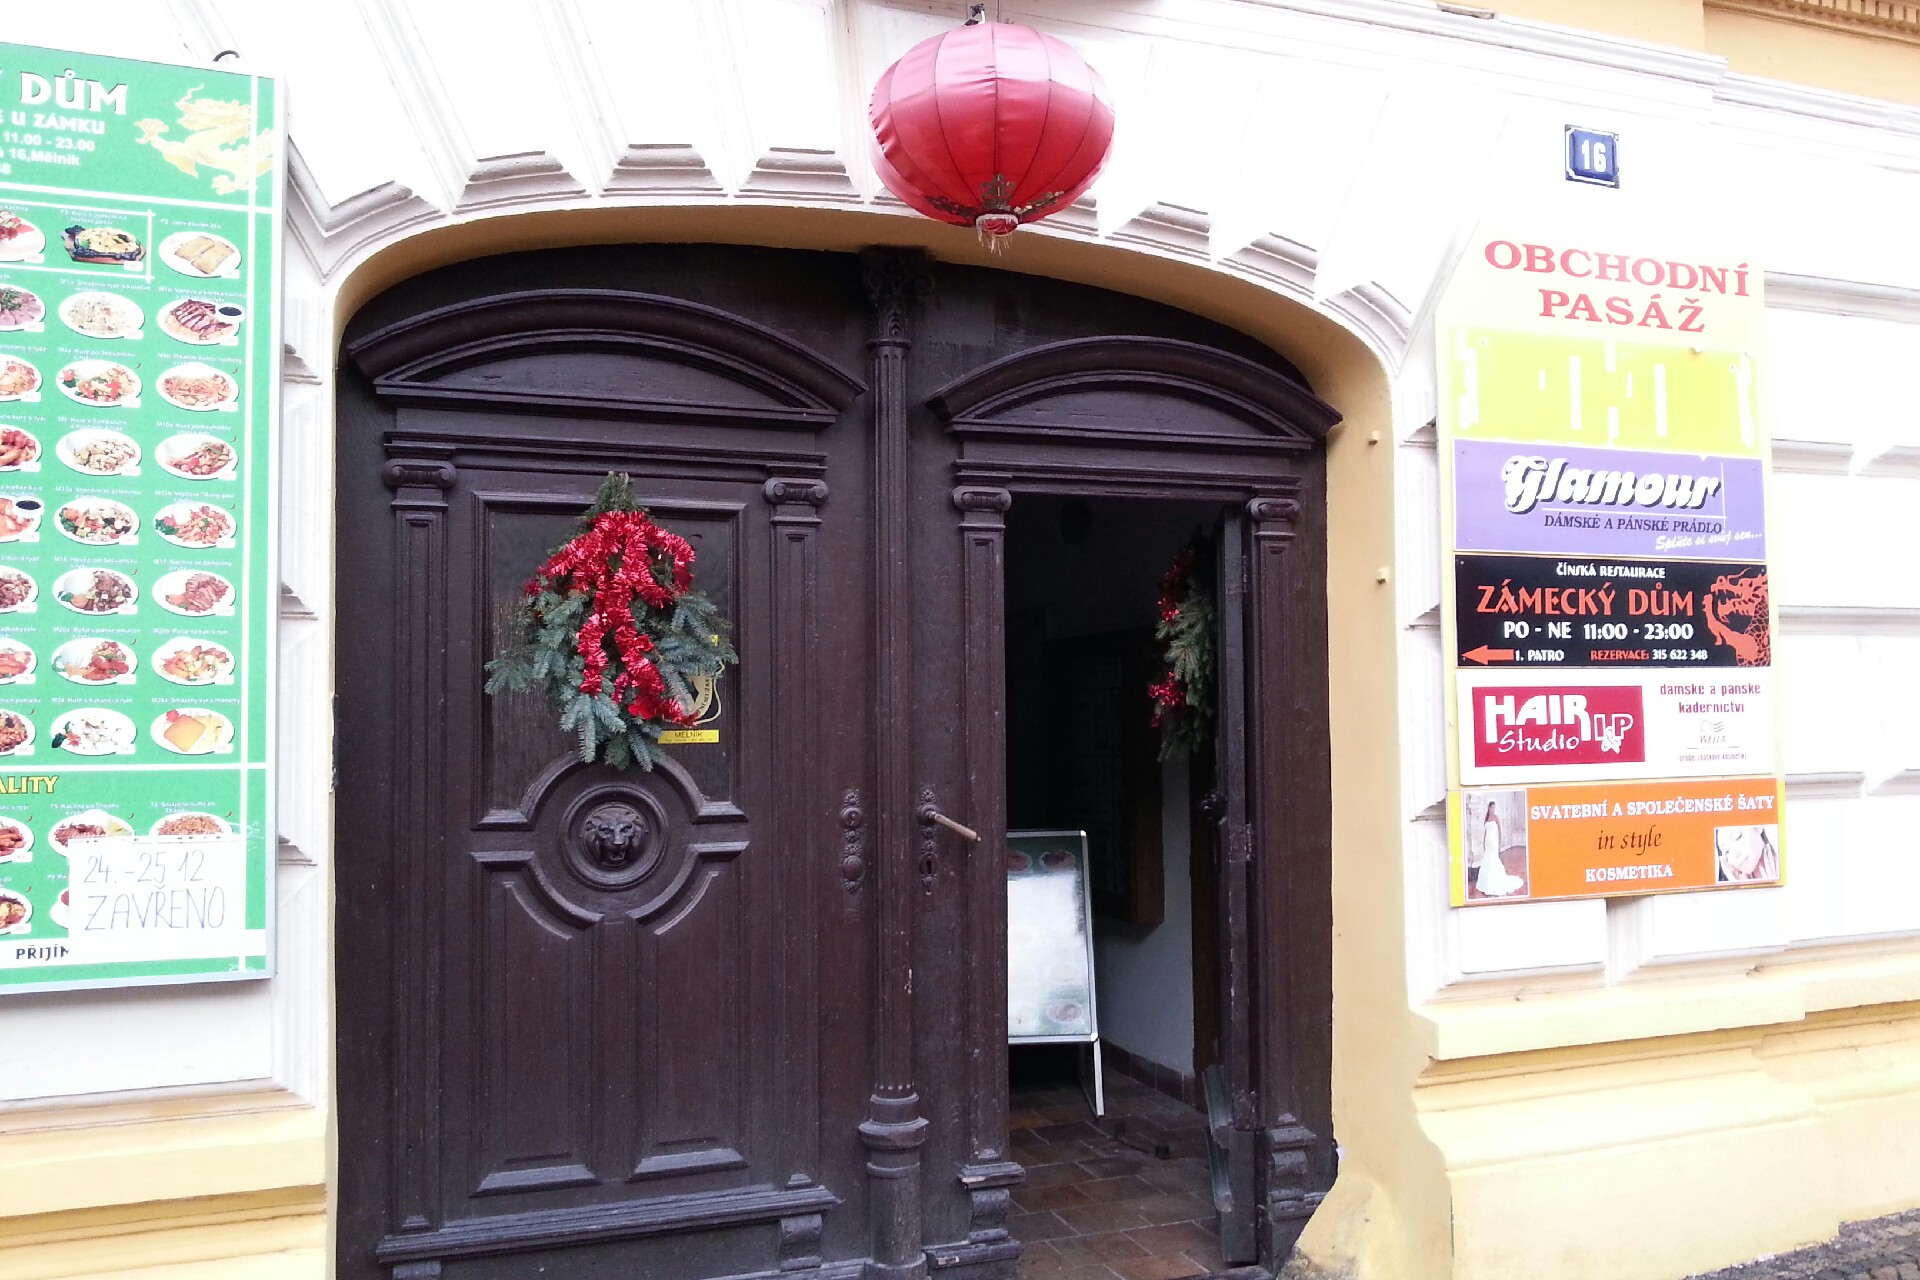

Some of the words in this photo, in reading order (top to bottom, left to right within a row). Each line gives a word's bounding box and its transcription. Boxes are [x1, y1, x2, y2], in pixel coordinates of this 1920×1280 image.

[20, 68, 128, 115] DŮM
[12, 111, 26, 126] U
[33, 112, 105, 135] ZÁMKU
[3, 131, 42, 146] 11.00
[55, 135, 95, 152] 23.00
[1581, 139, 1607, 173] 16
[1484, 240, 1750, 297] OBCHODNÍ
[1538, 288, 1706, 333] PASÁŽ
[1501, 454, 1722, 515] Glamour
[1544, 512, 1600, 529] DÁMSKÉ
[1603, 518, 1614, 530] A
[1616, 515, 1669, 532] PÁNSKÉ
[1672, 516, 1722, 534] PRÁDLO
[1556, 562, 1597, 577] ČÍNSKÁ
[1599, 565, 1666, 579] RESTAURACE
[1476, 578, 1616, 616] ZÁMECKÝ
[1628, 582, 1694, 617] DŮM
[1503, 620, 1530, 639] PO
[1548, 621, 1572, 640] NE
[1583, 622, 1628, 640] 11:00
[1644, 622, 1694, 641] 23:00
[1515, 649, 1524, 662] 1.
[1527, 649, 1565, 662] PATRO
[1590, 649, 1649, 662] REZERVACE:
[1652, 649, 1667, 660] 315
[1669, 649, 1687, 661] 622
[1690, 649, 1708, 661] 348
[1709, 684, 1716, 695] a
[1484, 694, 1592, 744] HAIR
[1498, 727, 1580, 753] Studio
[1530, 799, 1607, 821] SVATEBNÍ
[1611, 802, 1623, 817] A
[1626, 794, 1734, 816] SPOLEČENSKÉ
[1737, 793, 1775, 810] ŠATY
[1597, 830, 1615, 850] in
[1620, 825, 1662, 856] style
[1585, 863, 1674, 883] KOSMETIKA
[85, 884, 225, 931] ZAVŘENO
